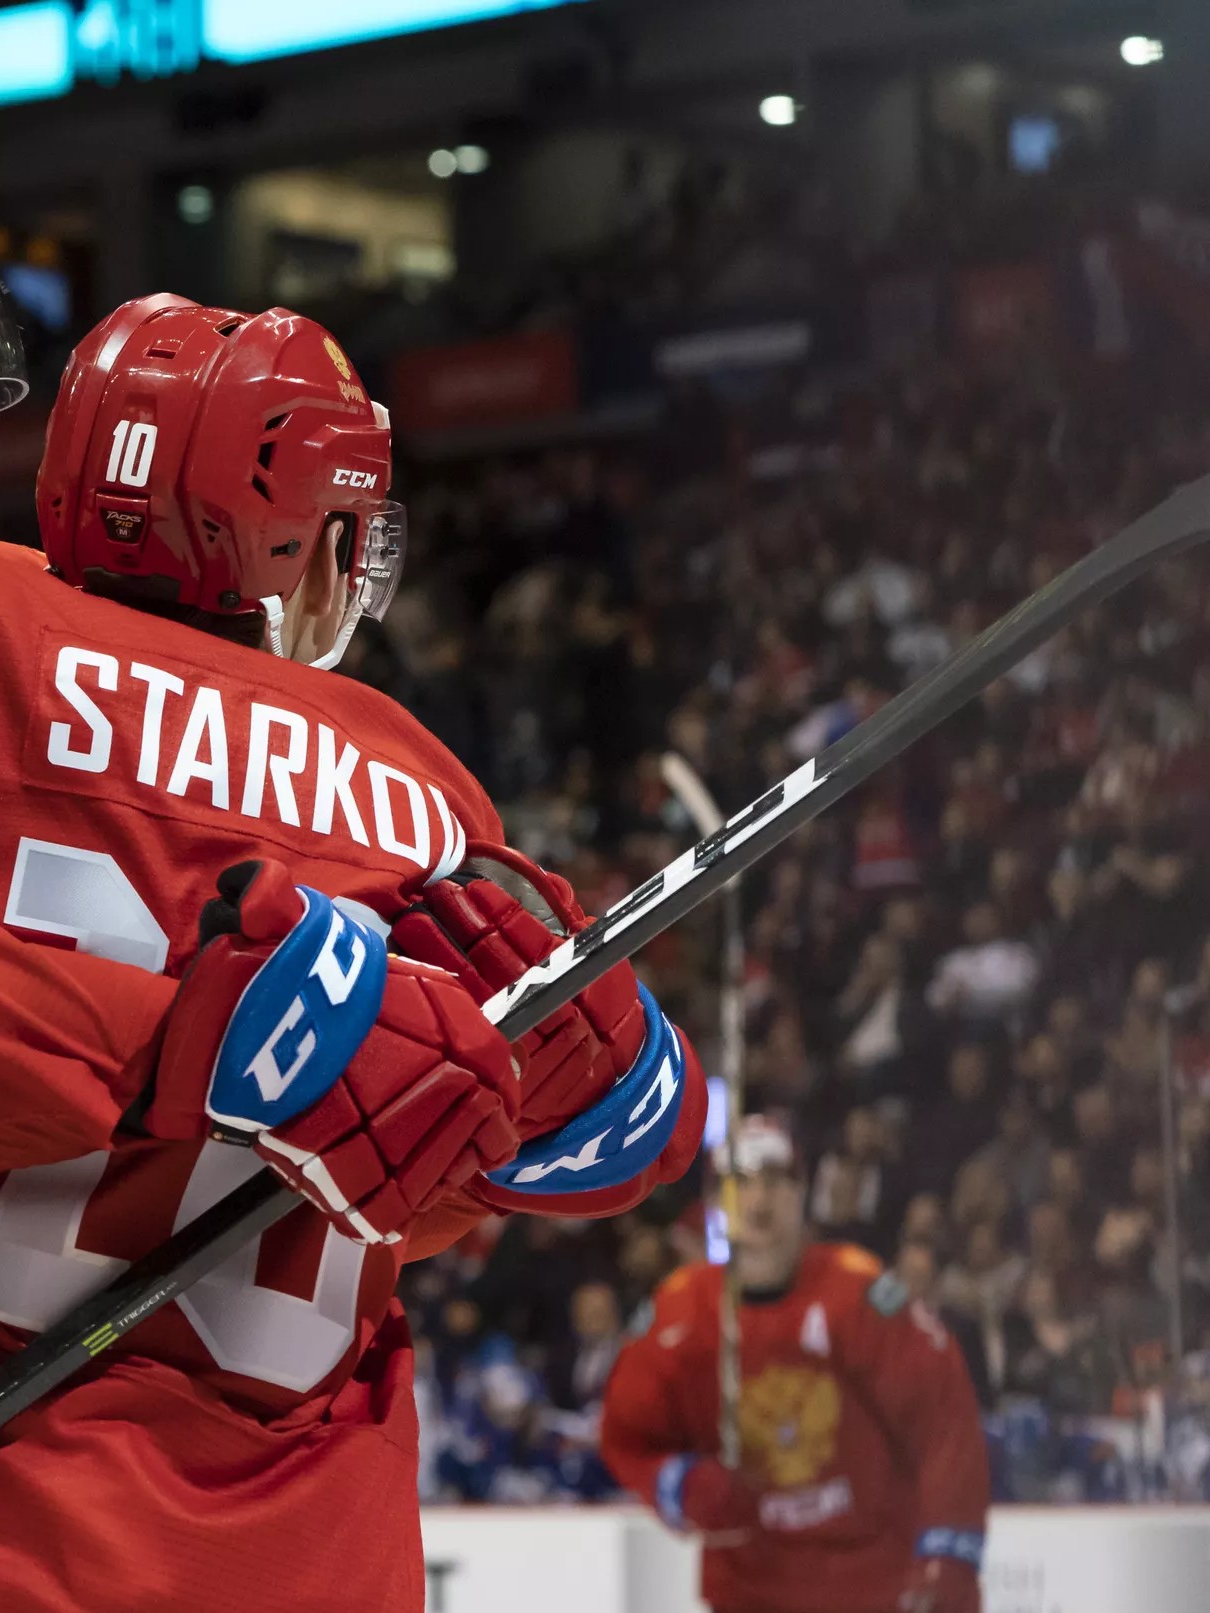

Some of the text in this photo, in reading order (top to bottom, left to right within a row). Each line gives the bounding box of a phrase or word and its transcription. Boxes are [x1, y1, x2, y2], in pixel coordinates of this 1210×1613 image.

[105, 419, 158, 488] 10
[332, 467, 377, 490] CCM
[106, 510, 142, 523] TACKS
[480, 757, 829, 1026] CCM
